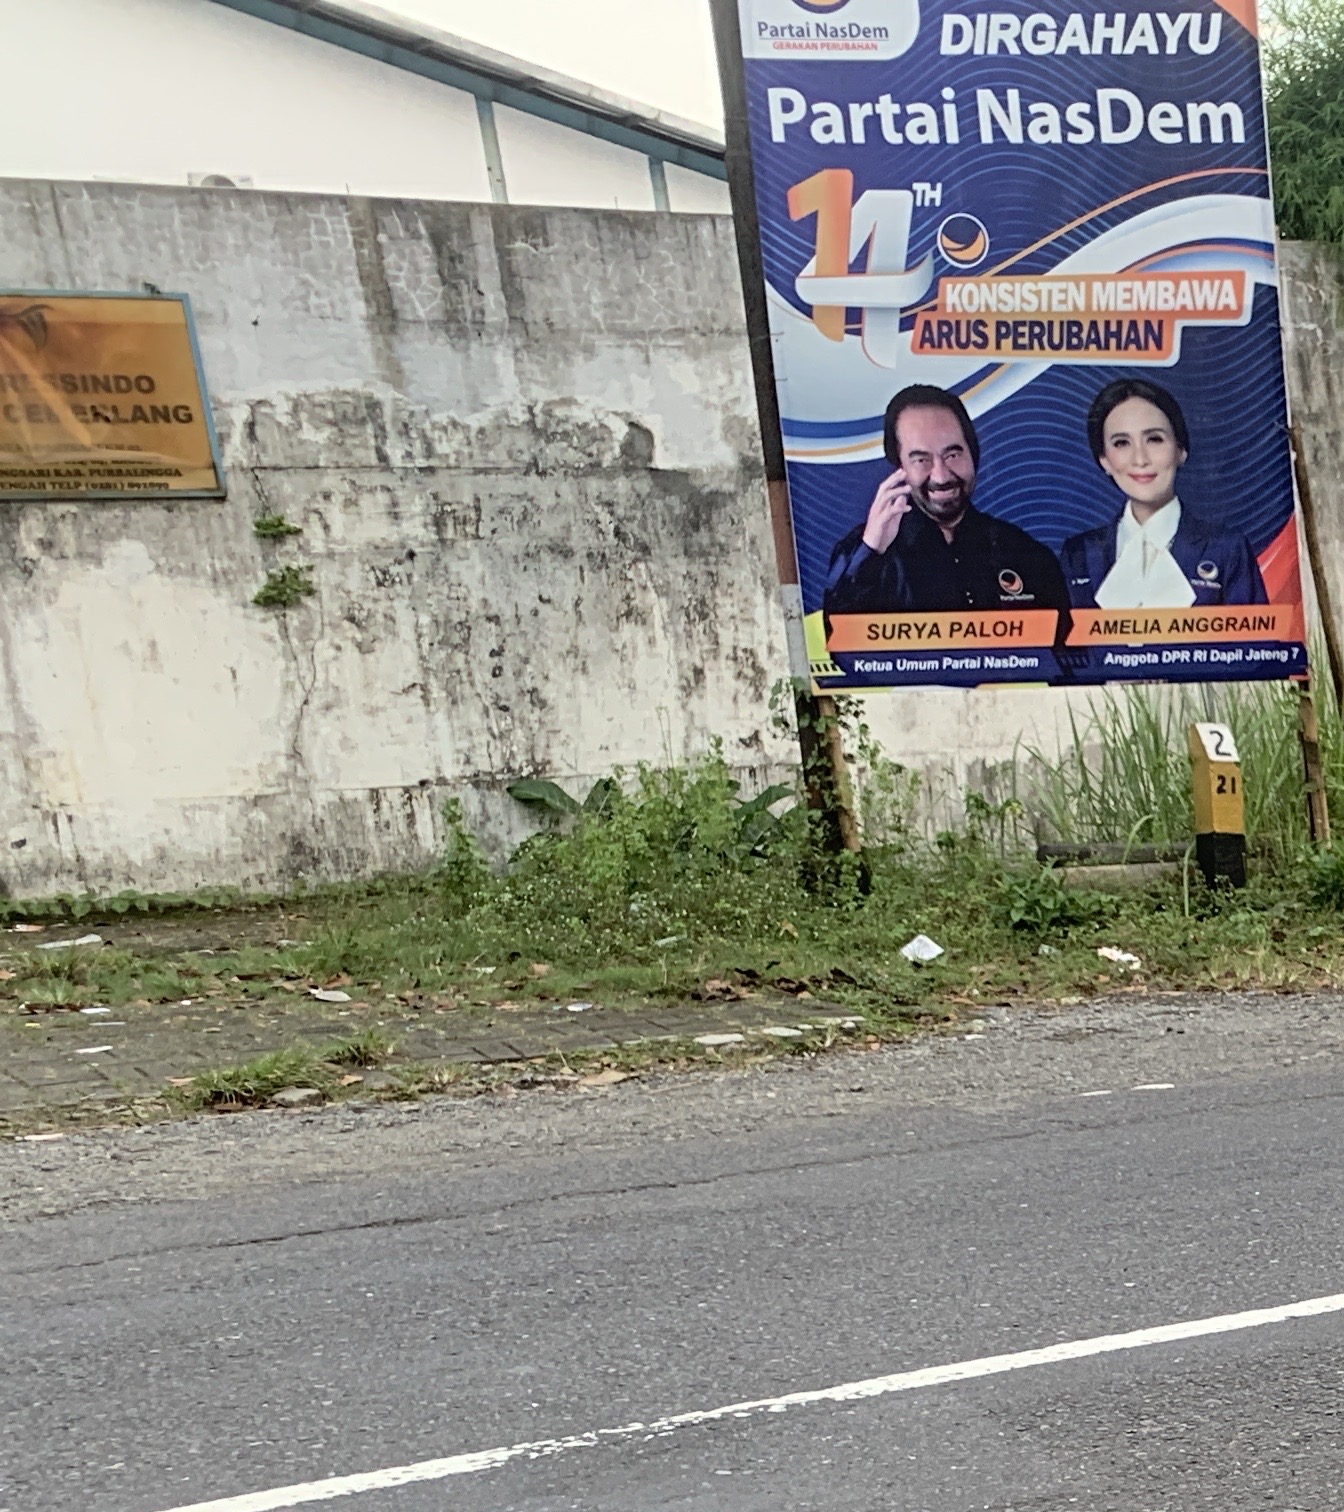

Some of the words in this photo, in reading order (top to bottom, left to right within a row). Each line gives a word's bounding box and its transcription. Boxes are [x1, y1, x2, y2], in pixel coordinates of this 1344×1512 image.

[757, 21, 811, 38] Partai
[815, 22, 889, 39] NasDem
[940, 12, 1221, 56] DIRGAHAYU
[772, 41, 819, 51] GERAKAN
[820, 41, 878, 51] PERUBAHAN
[767, 88, 962, 145] Partai
[978, 87, 1246, 145] NasDem
[944, 279, 1083, 313] KONSISTEN
[1090, 280, 1237, 312] MEMBAWA
[919, 319, 990, 351] ARUS
[996, 320, 1163, 352] PERUBAHAN
[866, 622, 942, 641] SURYA
[949, 621, 1024, 640] PALOH
[1089, 618, 1162, 637] AMELIA
[1168, 615, 1276, 634] ANGGRAINI
[854, 658, 892, 672] Ketua
[896, 658, 936, 671] Umum
[942, 657, 979, 670] Partai
[983, 655, 1039, 670] NasDem
[1104, 650, 1158, 668] Anggota
[1162, 650, 1190, 664] DPR
[1192, 650, 1208, 664] RI
[1210, 649, 1241, 667] Dapil
[1245, 648, 1287, 666] Jateng
[1290, 647, 1300, 661] 7
[1209, 730, 1232, 756] 2
[1216, 775, 1236, 795] 21
